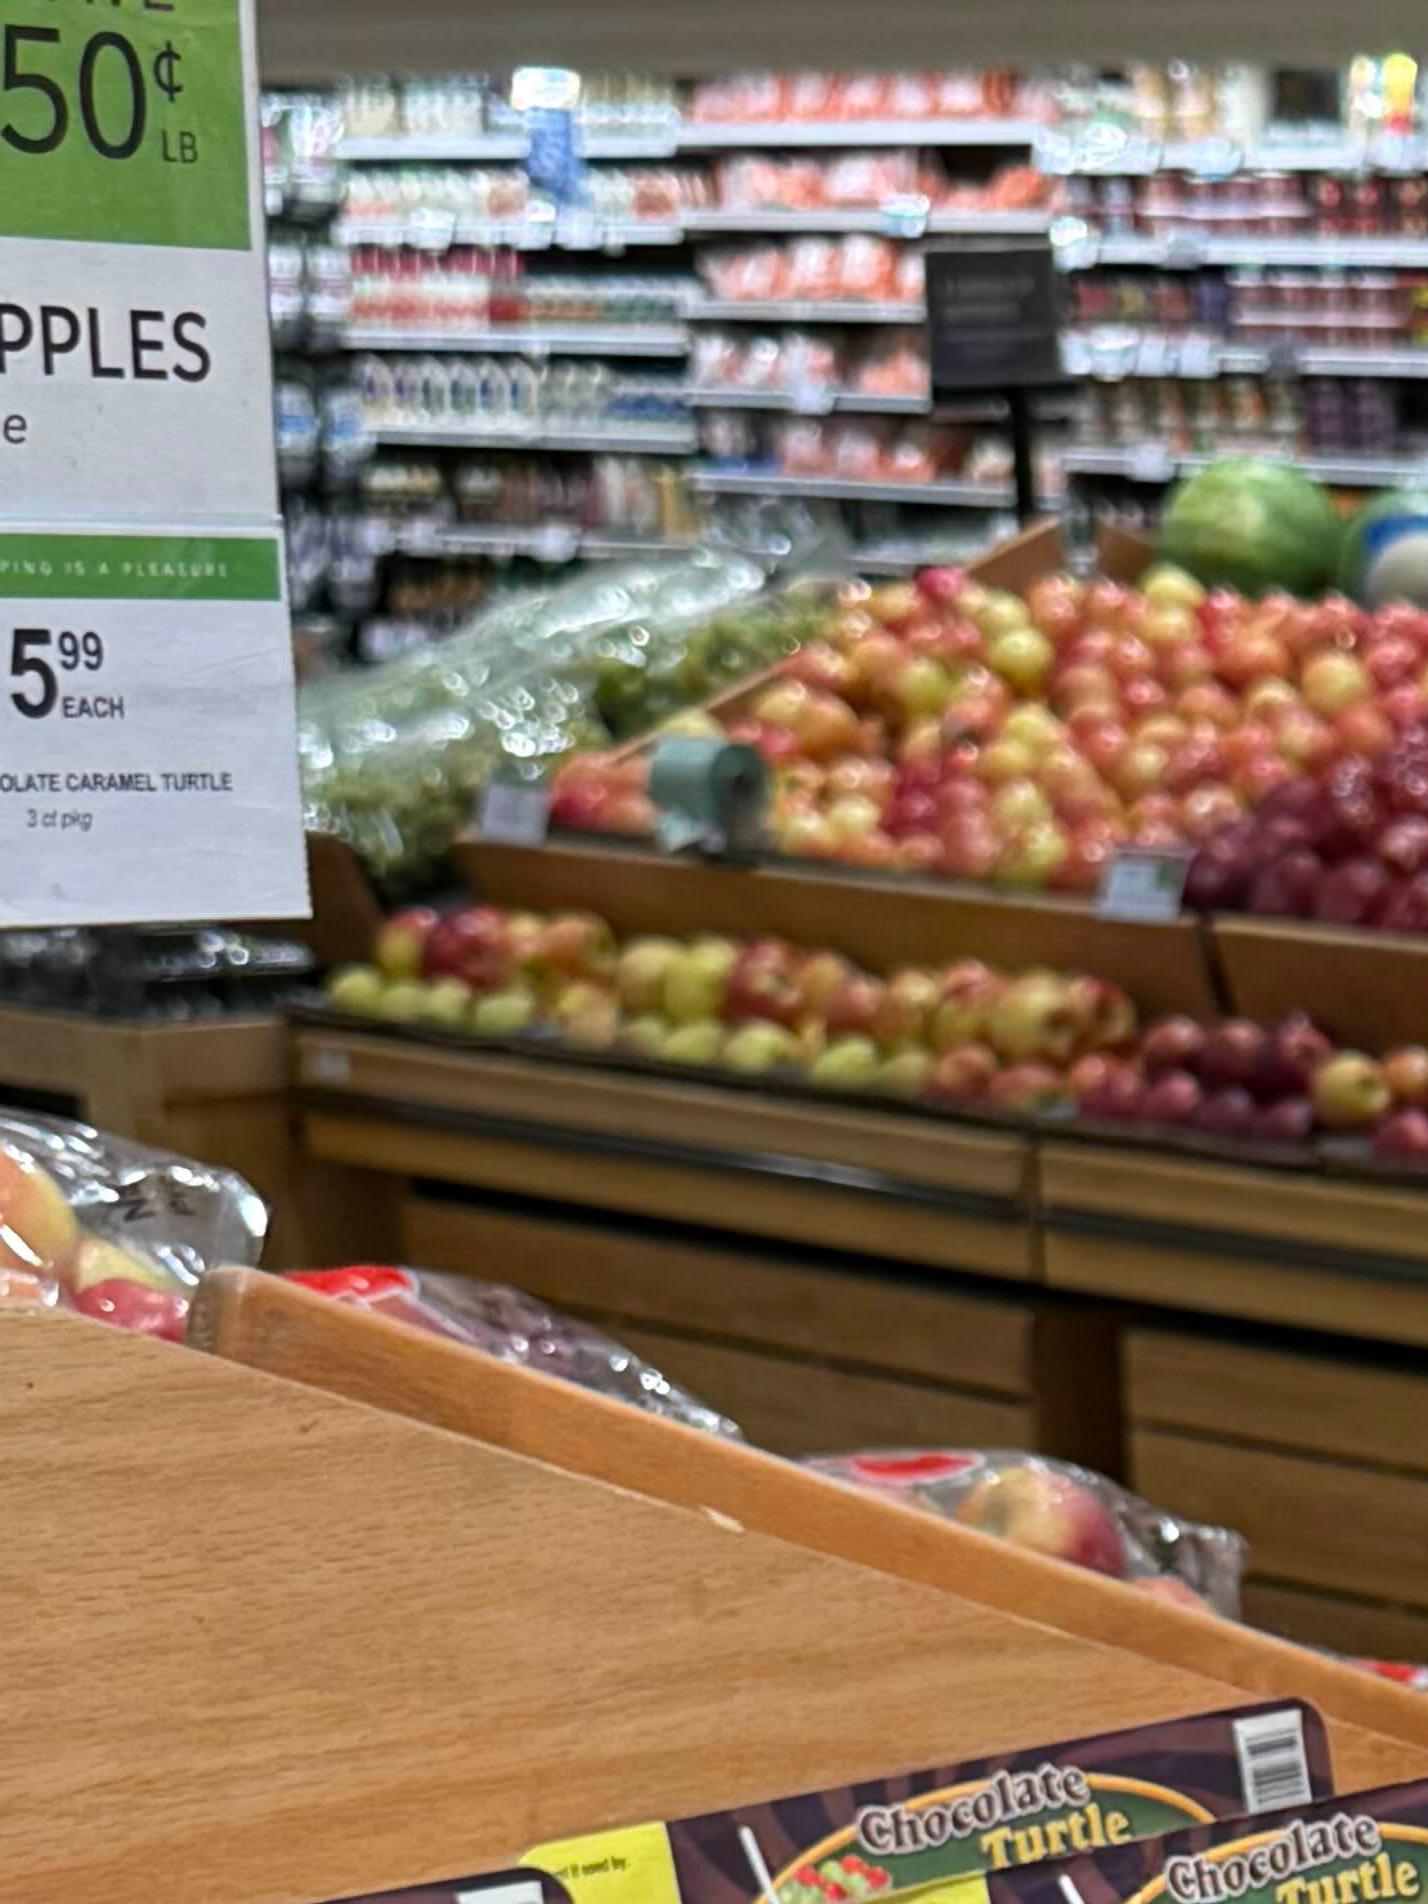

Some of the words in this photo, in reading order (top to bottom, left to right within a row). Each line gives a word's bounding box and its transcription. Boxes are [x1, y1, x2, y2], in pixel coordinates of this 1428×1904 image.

[161, 128, 199, 163] LB
[99, 562, 110, 577] A
[62, 696, 125, 718] EACH
[65, 773, 157, 793] CARAMEL
[161, 772, 232, 792] TURTLE
[26, 808, 37, 828] 3
[60, 810, 93, 832] pkg
[858, 1762, 1090, 1855] Chocolate
[981, 1802, 1132, 1870] Turtle
[1165, 1812, 1383, 1904] Chocolate
